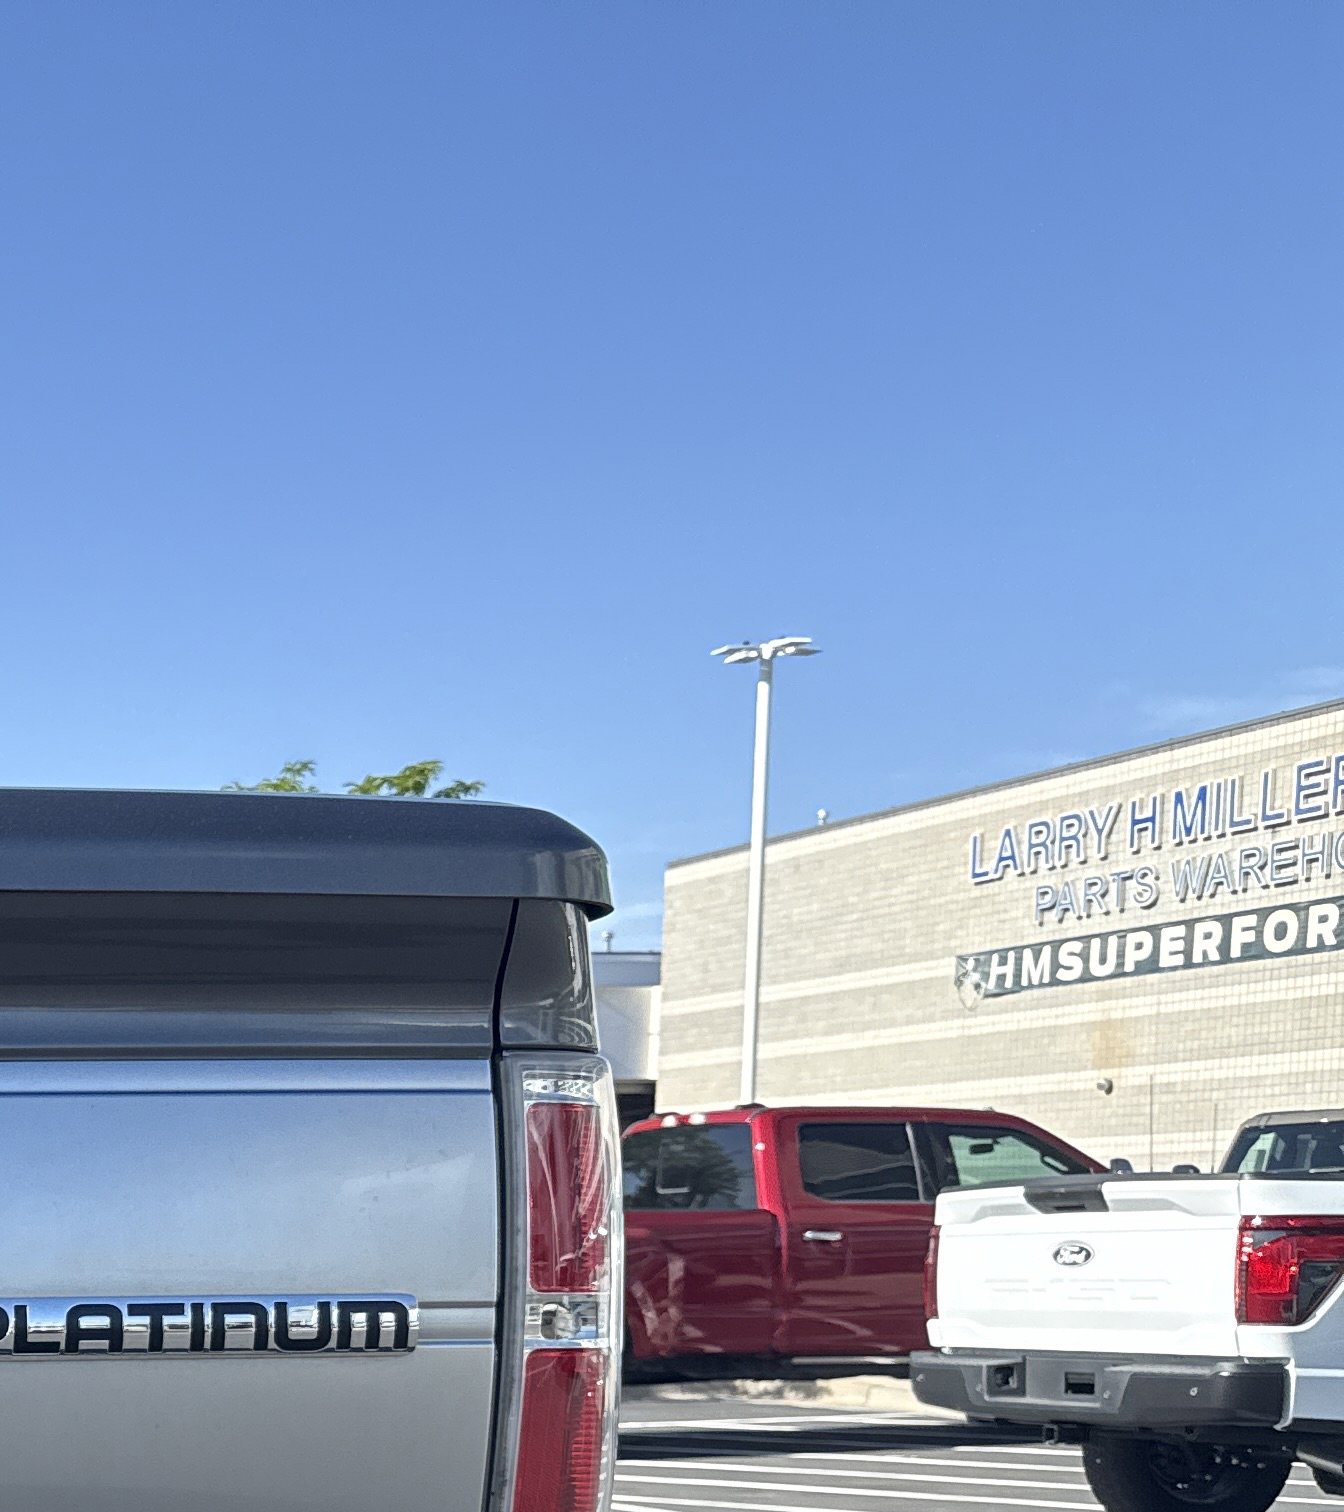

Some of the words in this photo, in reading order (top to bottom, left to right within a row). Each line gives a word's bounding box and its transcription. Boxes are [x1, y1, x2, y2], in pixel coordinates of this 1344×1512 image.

[969, 802, 1115, 881] LARRY
[1129, 796, 1159, 851] H
[1035, 865, 1158, 922] PARTS
